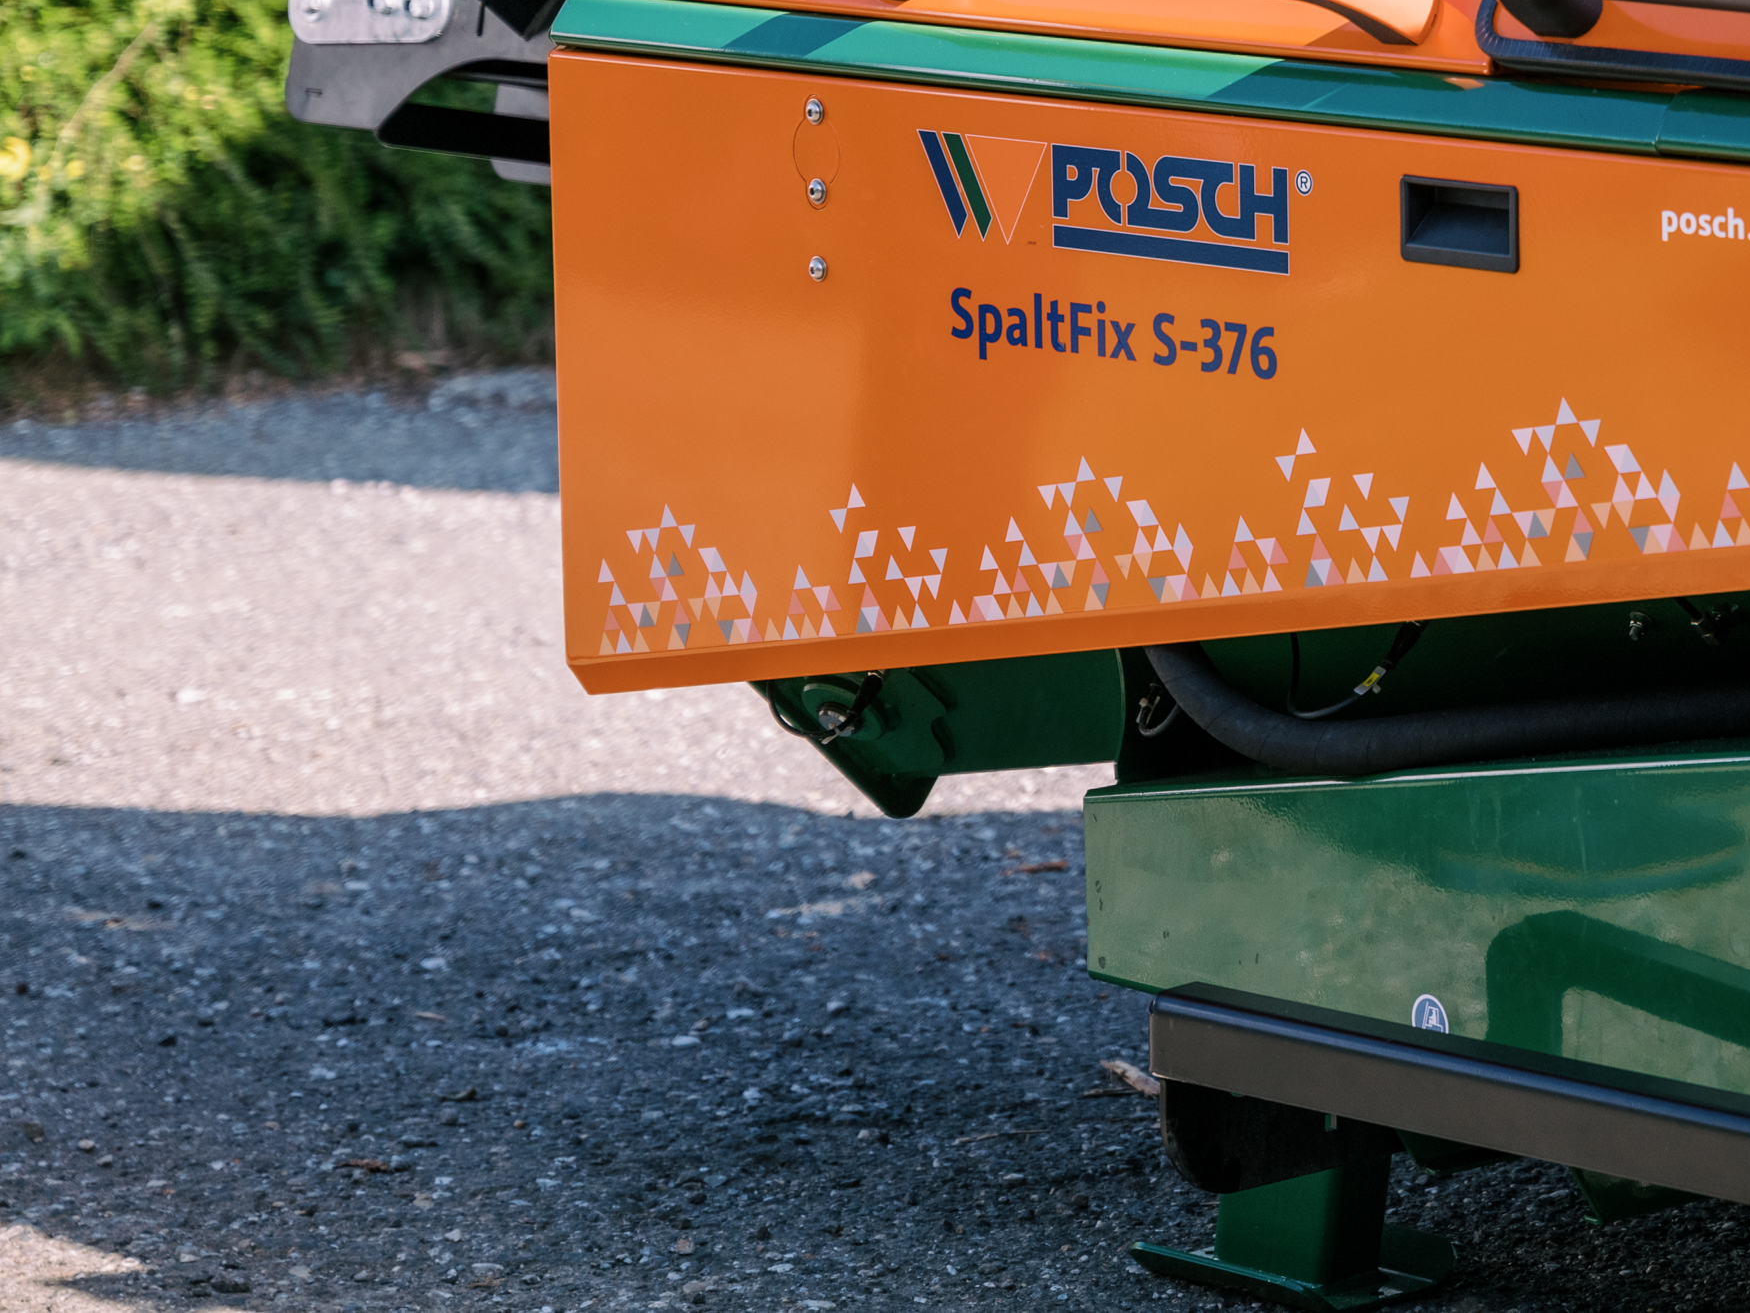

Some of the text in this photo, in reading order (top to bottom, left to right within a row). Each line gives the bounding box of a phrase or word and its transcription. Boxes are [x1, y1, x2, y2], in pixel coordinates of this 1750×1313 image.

[1050, 143, 1289, 245] POSCH
[950, 286, 1278, 380] SpaltFix S-376
